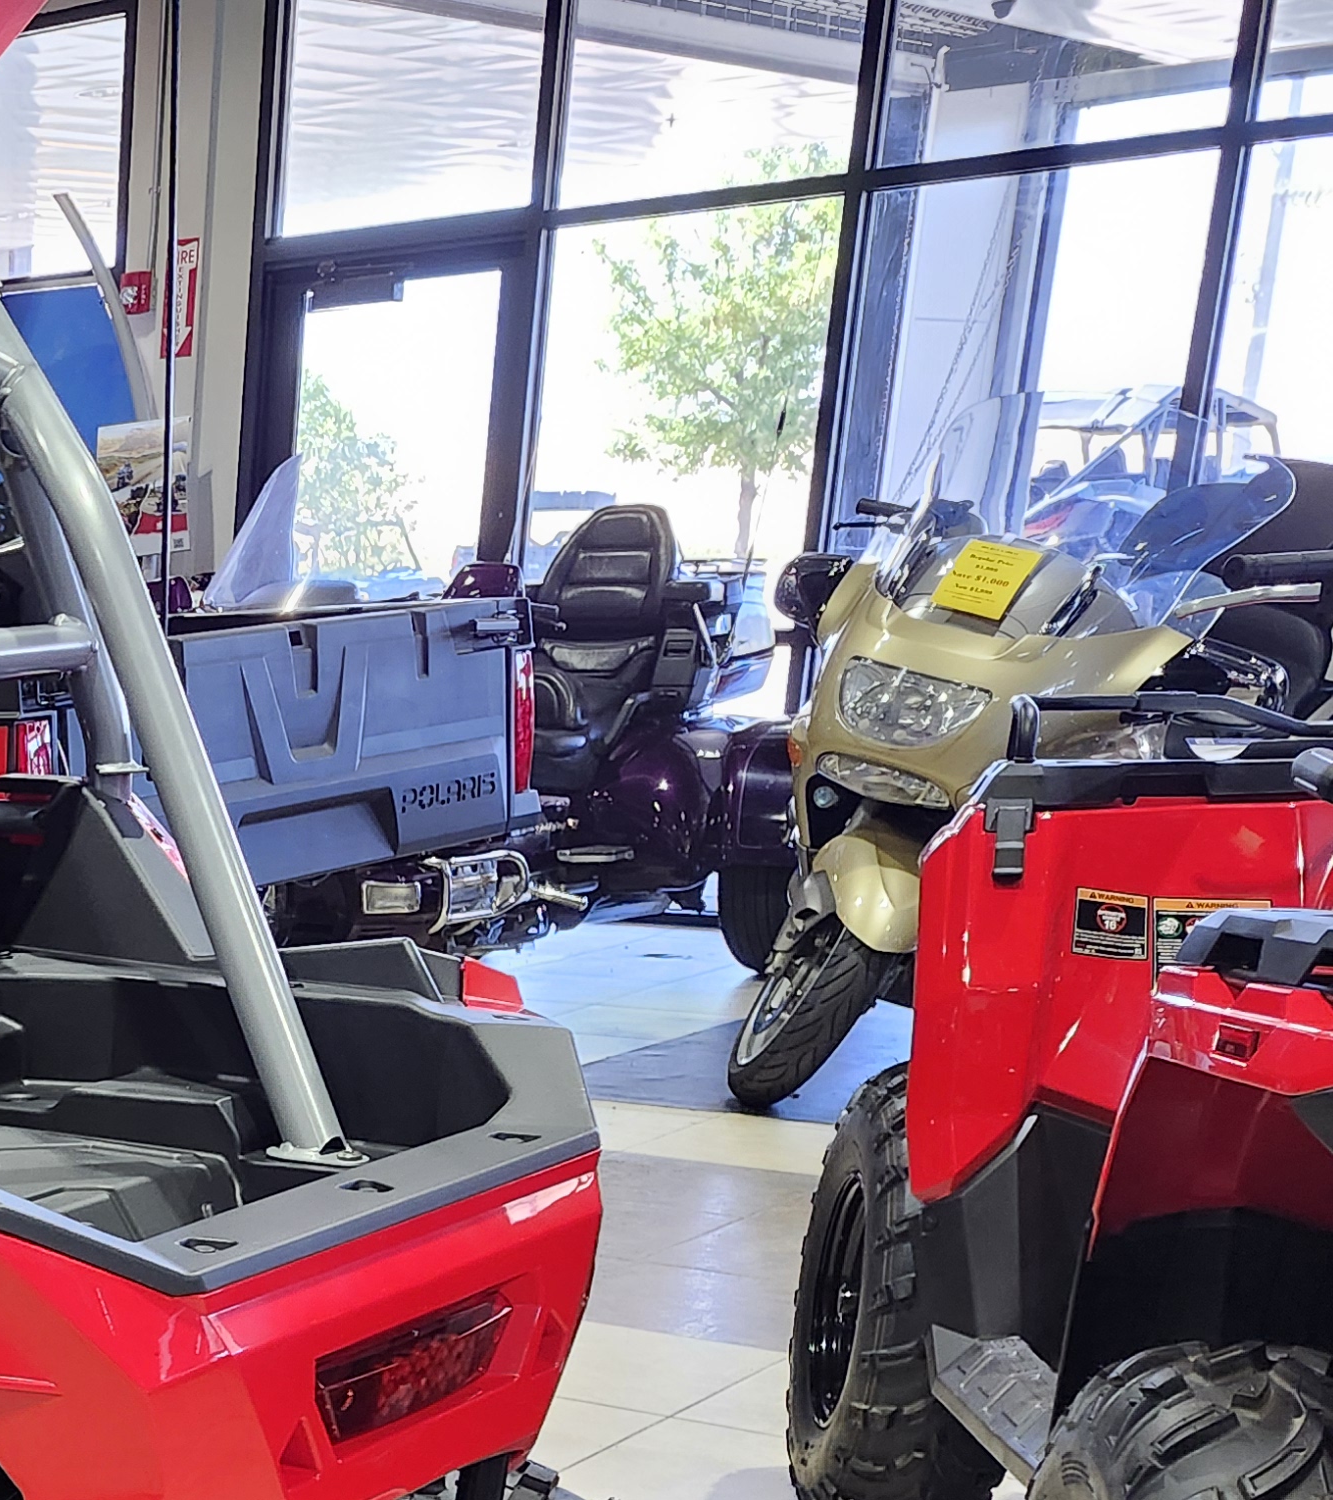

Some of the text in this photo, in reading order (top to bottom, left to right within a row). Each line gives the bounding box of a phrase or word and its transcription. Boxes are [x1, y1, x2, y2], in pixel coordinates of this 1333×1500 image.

[177, 249, 195, 264] IRE
[974, 575, 1010, 587] $1,000
[401, 772, 495, 813] POLARIS
[1097, 892, 1135, 904] WARNING
